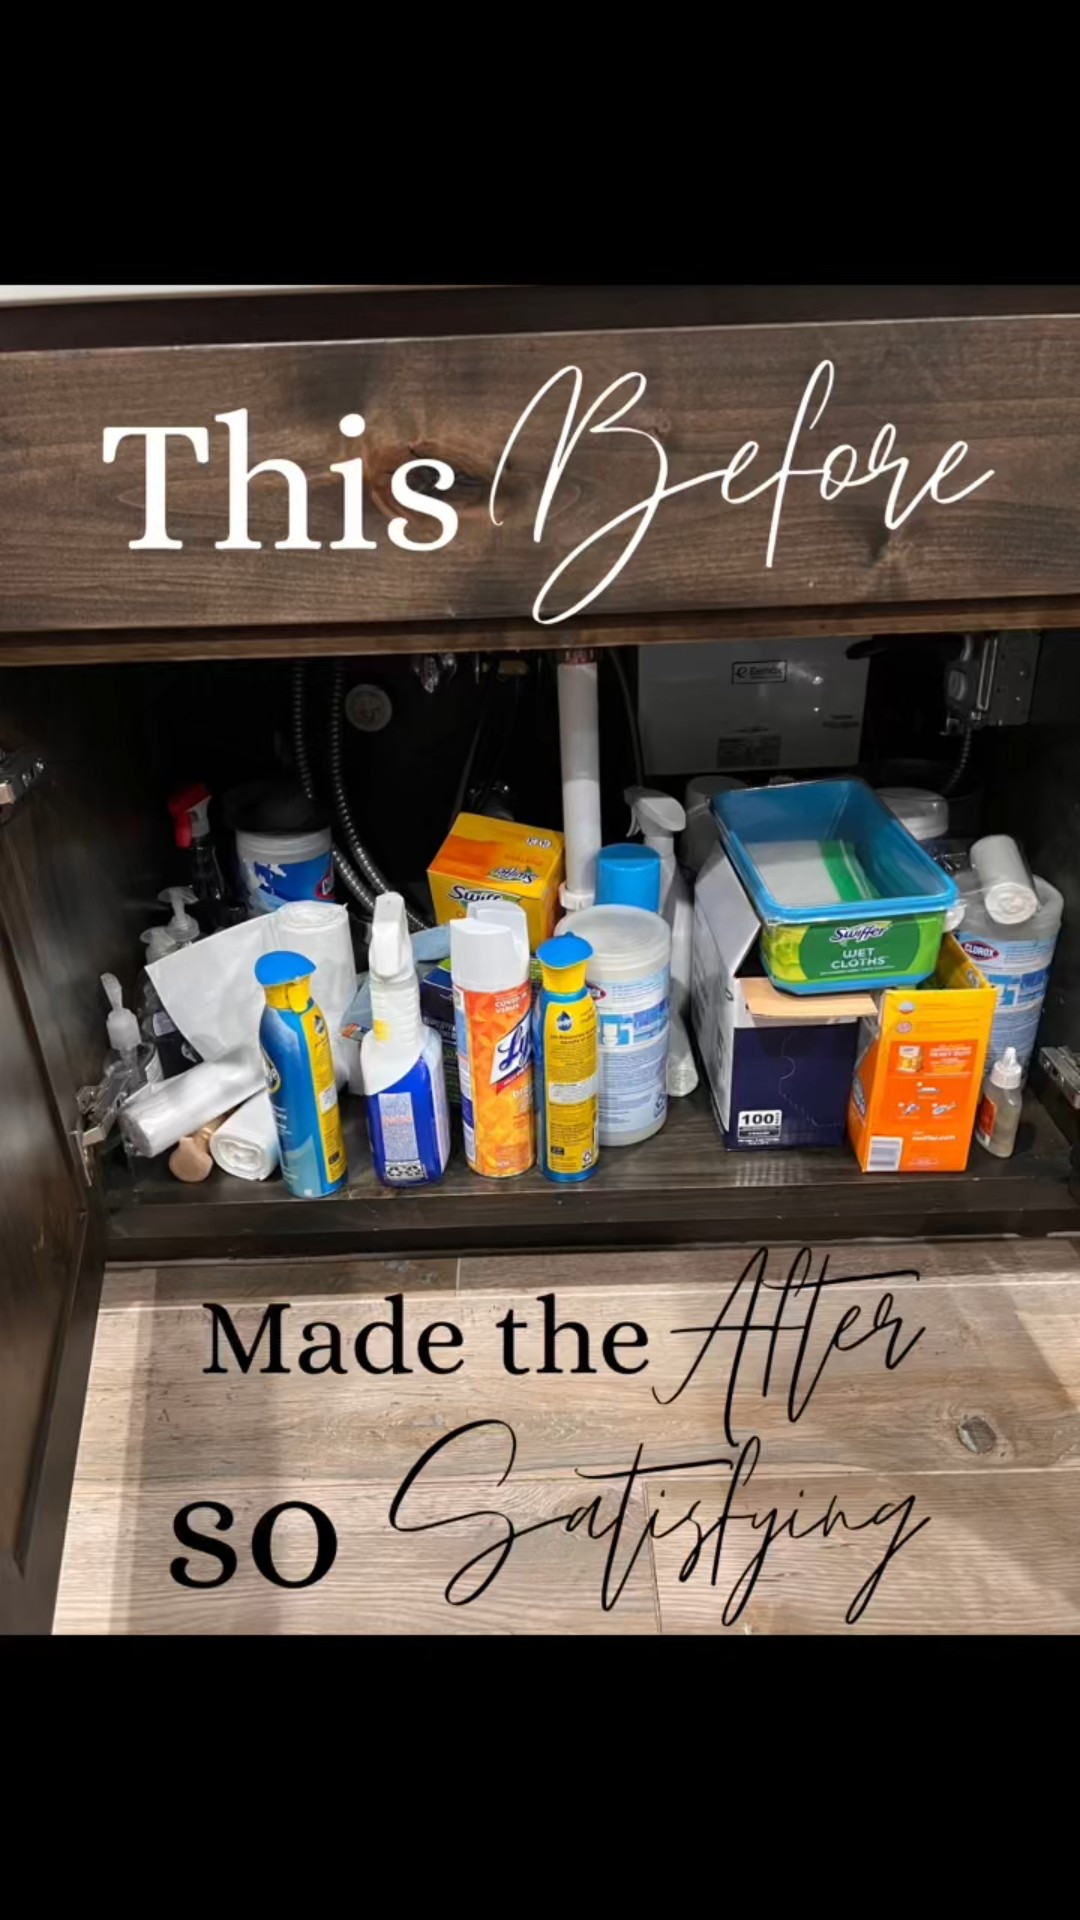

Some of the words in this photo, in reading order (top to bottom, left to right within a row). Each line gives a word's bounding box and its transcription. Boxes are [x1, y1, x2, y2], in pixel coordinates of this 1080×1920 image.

[829, 925, 889, 942] Swiffer
[842, 947, 876, 959] WET
[963, 942, 995, 957] CLOROX
[830, 956, 886, 970] CLOTHS
[742, 1113, 775, 1126] 100
